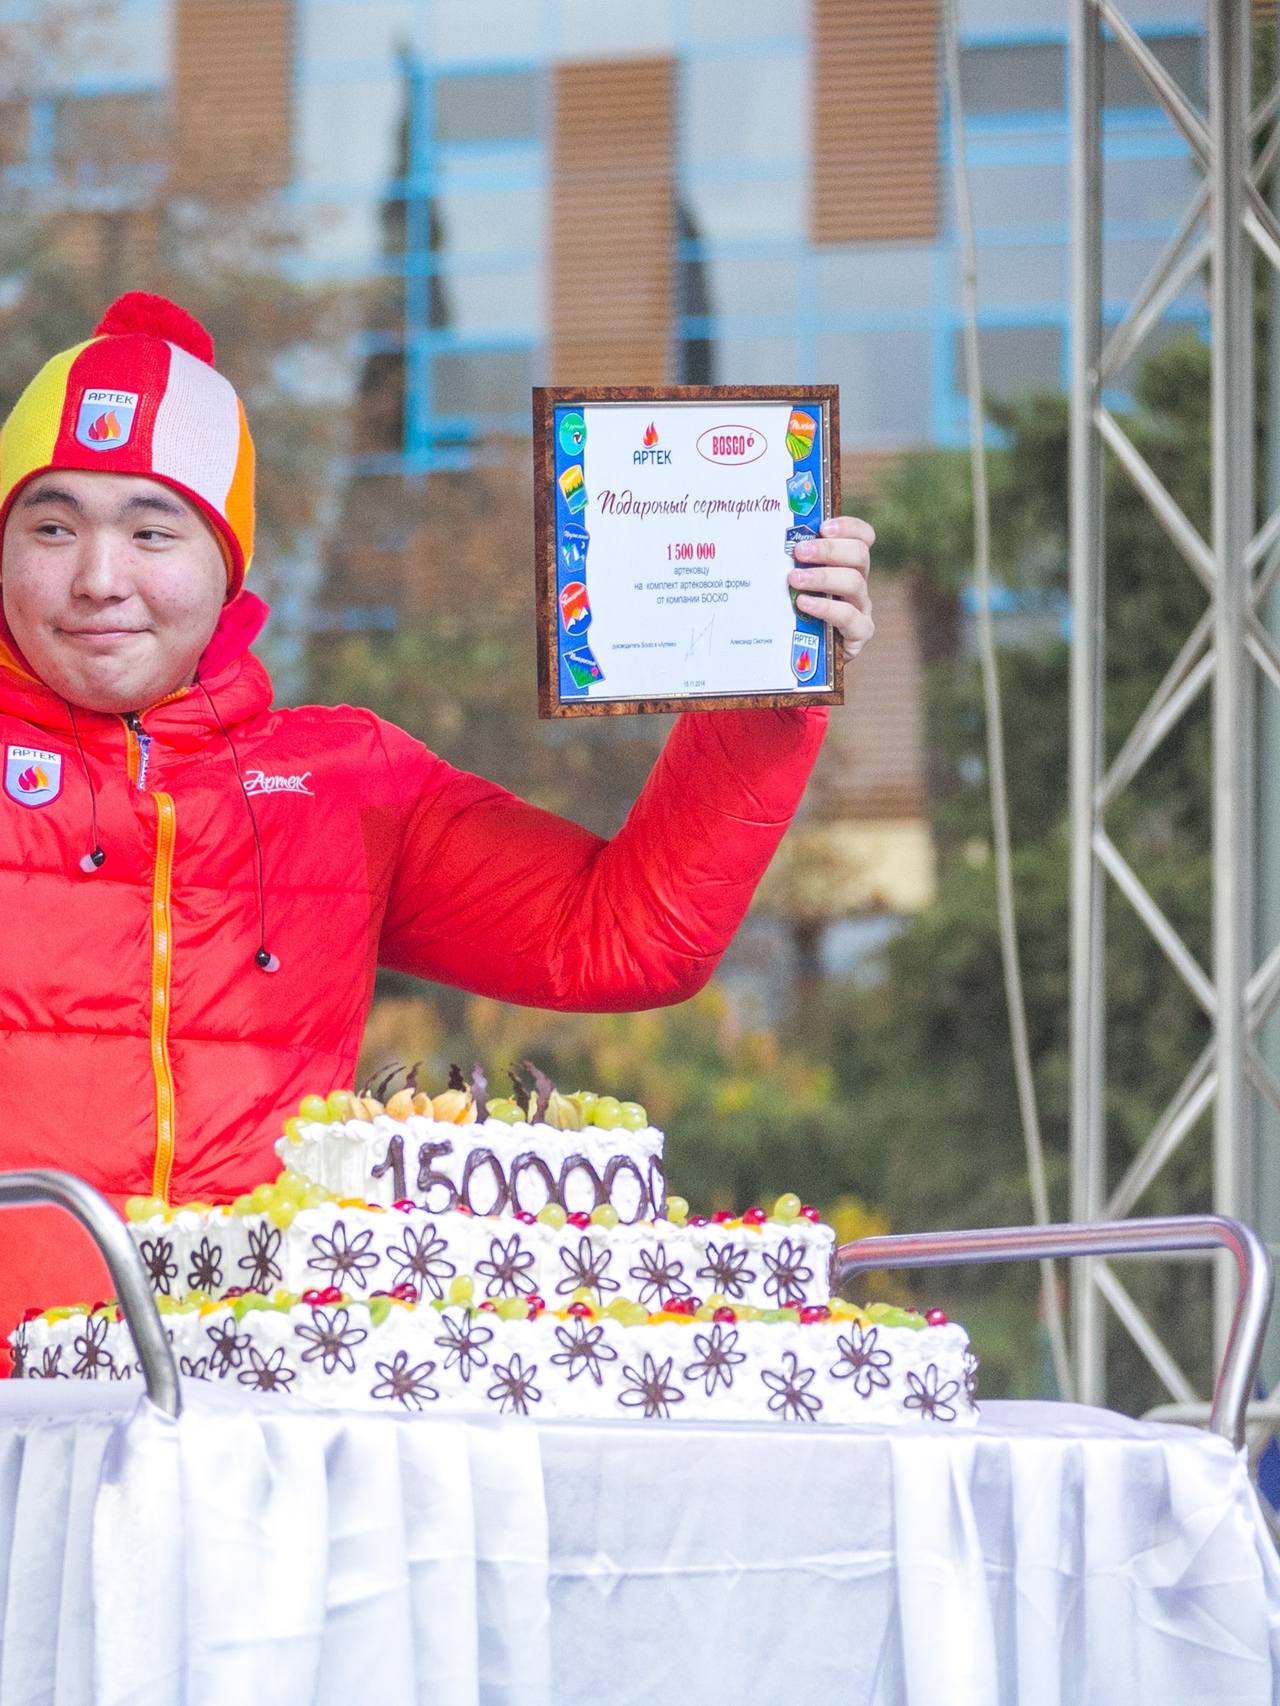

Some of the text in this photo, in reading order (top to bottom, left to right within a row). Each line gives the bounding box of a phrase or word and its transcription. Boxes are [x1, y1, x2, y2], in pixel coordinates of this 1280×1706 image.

[88, 392, 134, 405] АРТЕК
[712, 435, 746, 456] BOSCO
[633, 449, 672, 465] АРТЕК
[597, 489, 781, 520] Подарочный сертификат
[667, 542, 716, 561] 1 500 000
[674, 566, 710, 577] артековцу
[634, 578, 751, 591] на комплект артековской формы
[657, 592, 729, 604] от компании БОСКО
[794, 633, 818, 647] АРТЕК
[12, 748, 57, 761] АРТЕК
[244, 770, 313, 795] Артек
